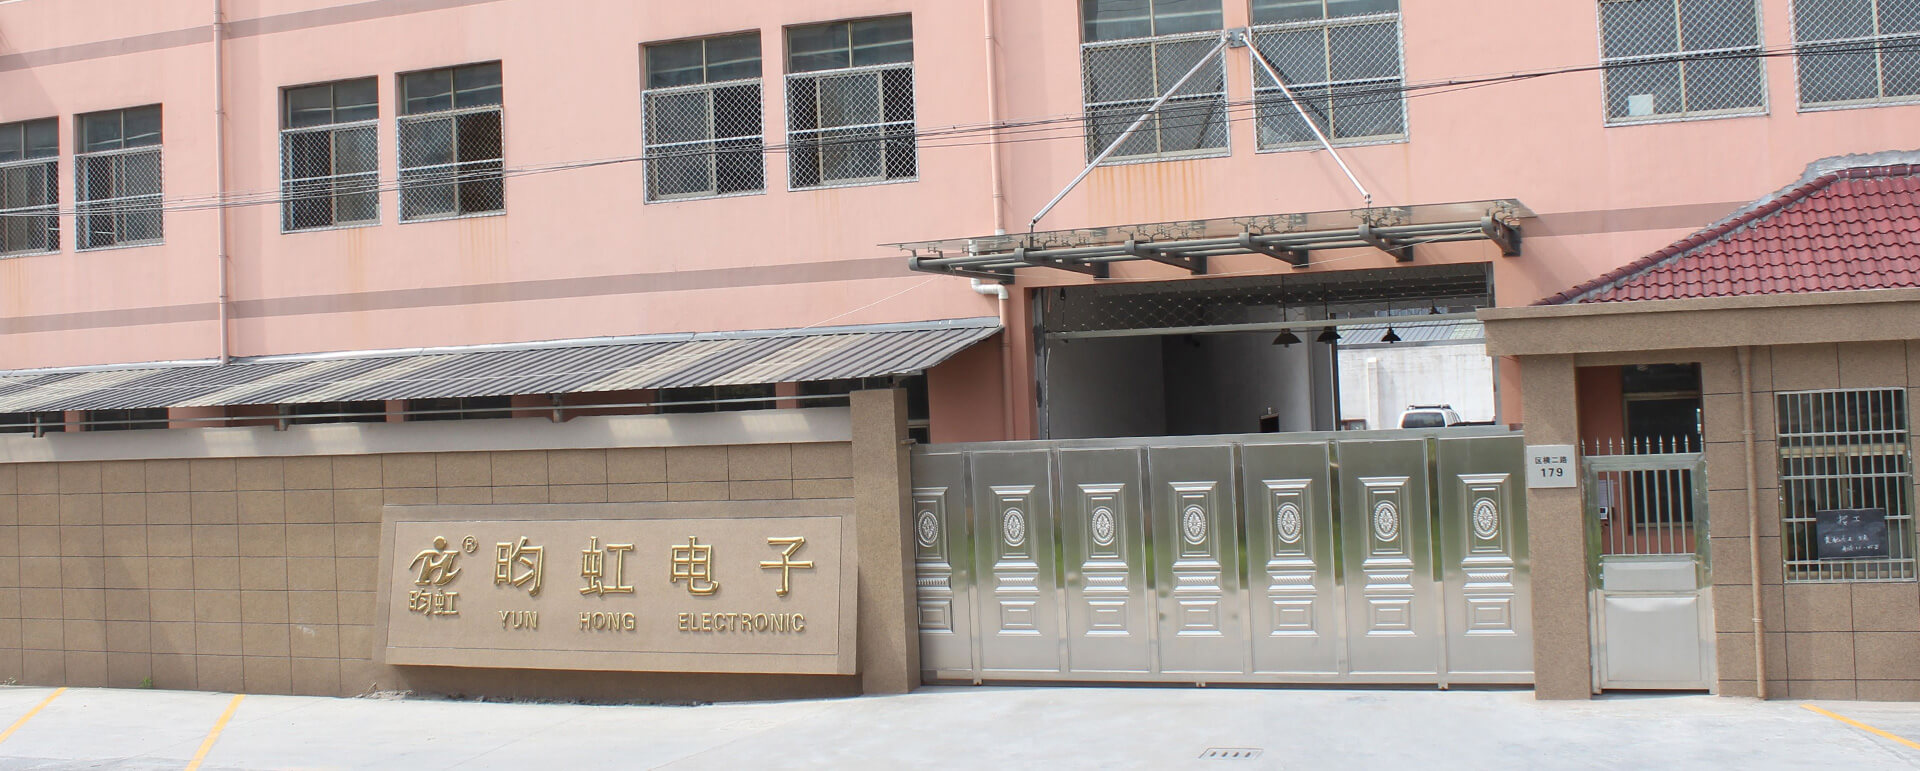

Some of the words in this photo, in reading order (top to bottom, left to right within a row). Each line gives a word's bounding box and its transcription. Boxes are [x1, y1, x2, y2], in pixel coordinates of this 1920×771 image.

[1541, 467, 1563, 477] 179
[494, 536, 814, 597] 昀虹电子
[409, 588, 459, 615] 昀虹
[498, 610, 538, 630] YUN
[579, 611, 636, 631] HONG
[678, 612, 805, 632] ELECTRONIC
